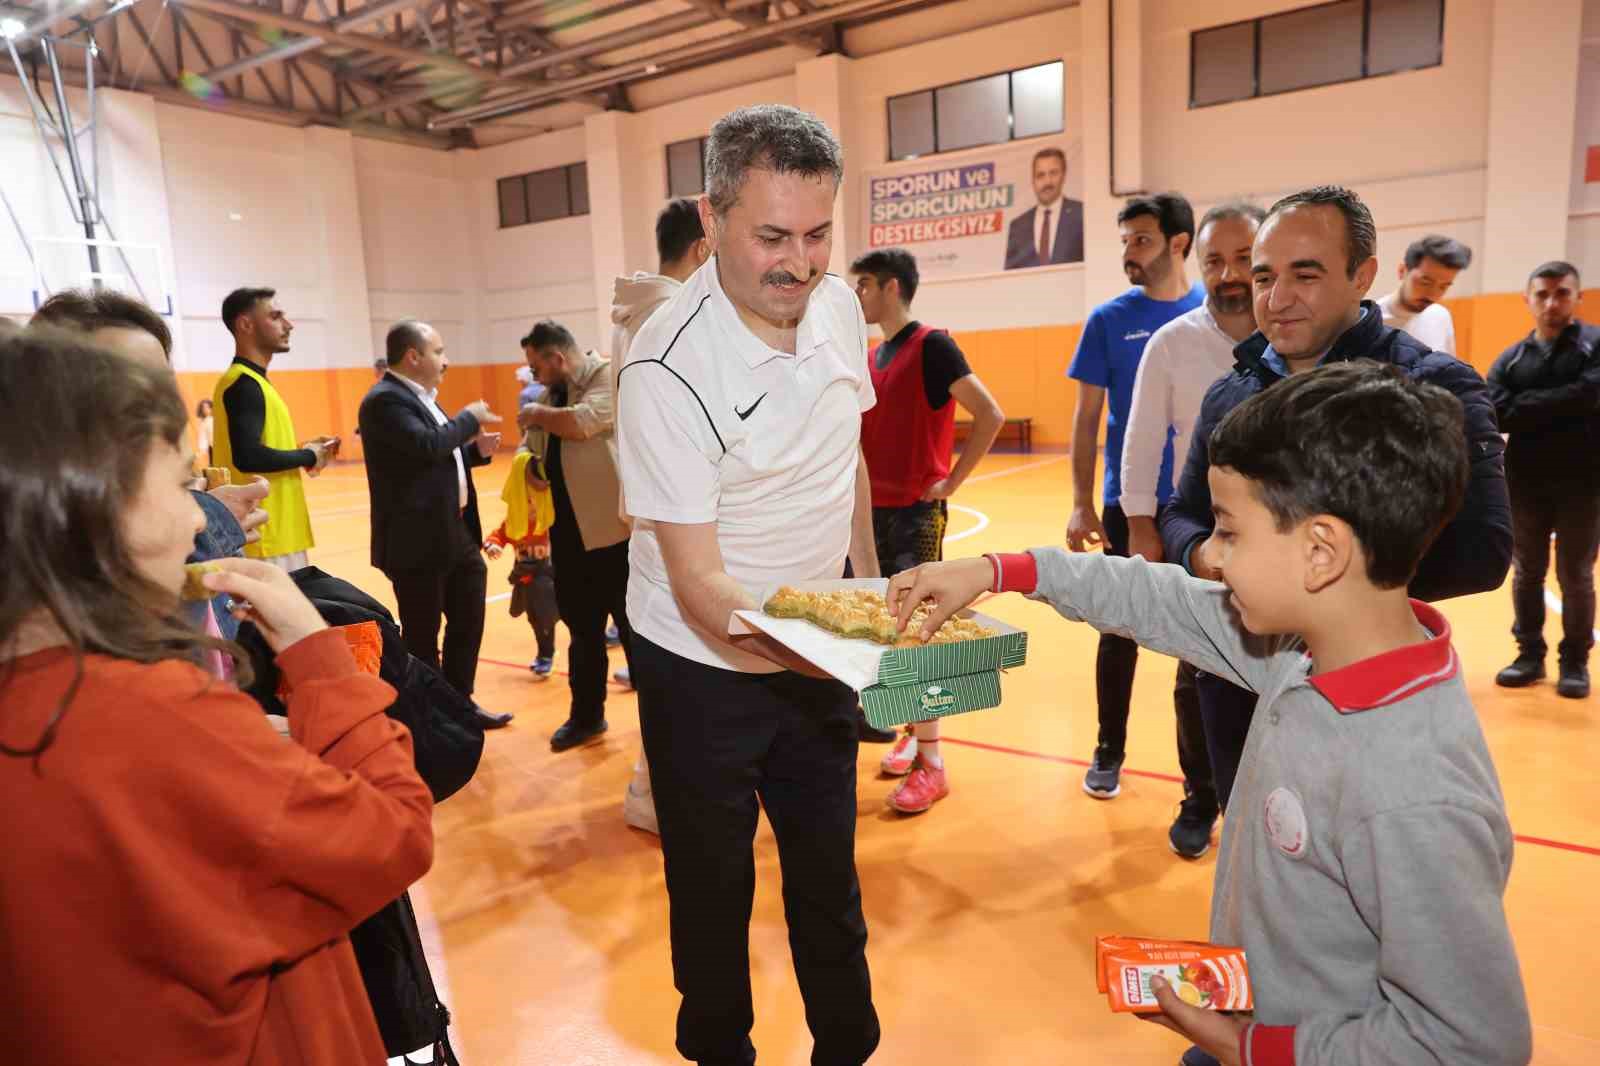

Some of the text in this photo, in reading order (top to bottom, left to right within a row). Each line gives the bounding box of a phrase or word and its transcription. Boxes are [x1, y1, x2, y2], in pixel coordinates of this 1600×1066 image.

[873, 168, 990, 199] SPORUN ve
[872, 186, 1009, 222] SPORCUNUN
